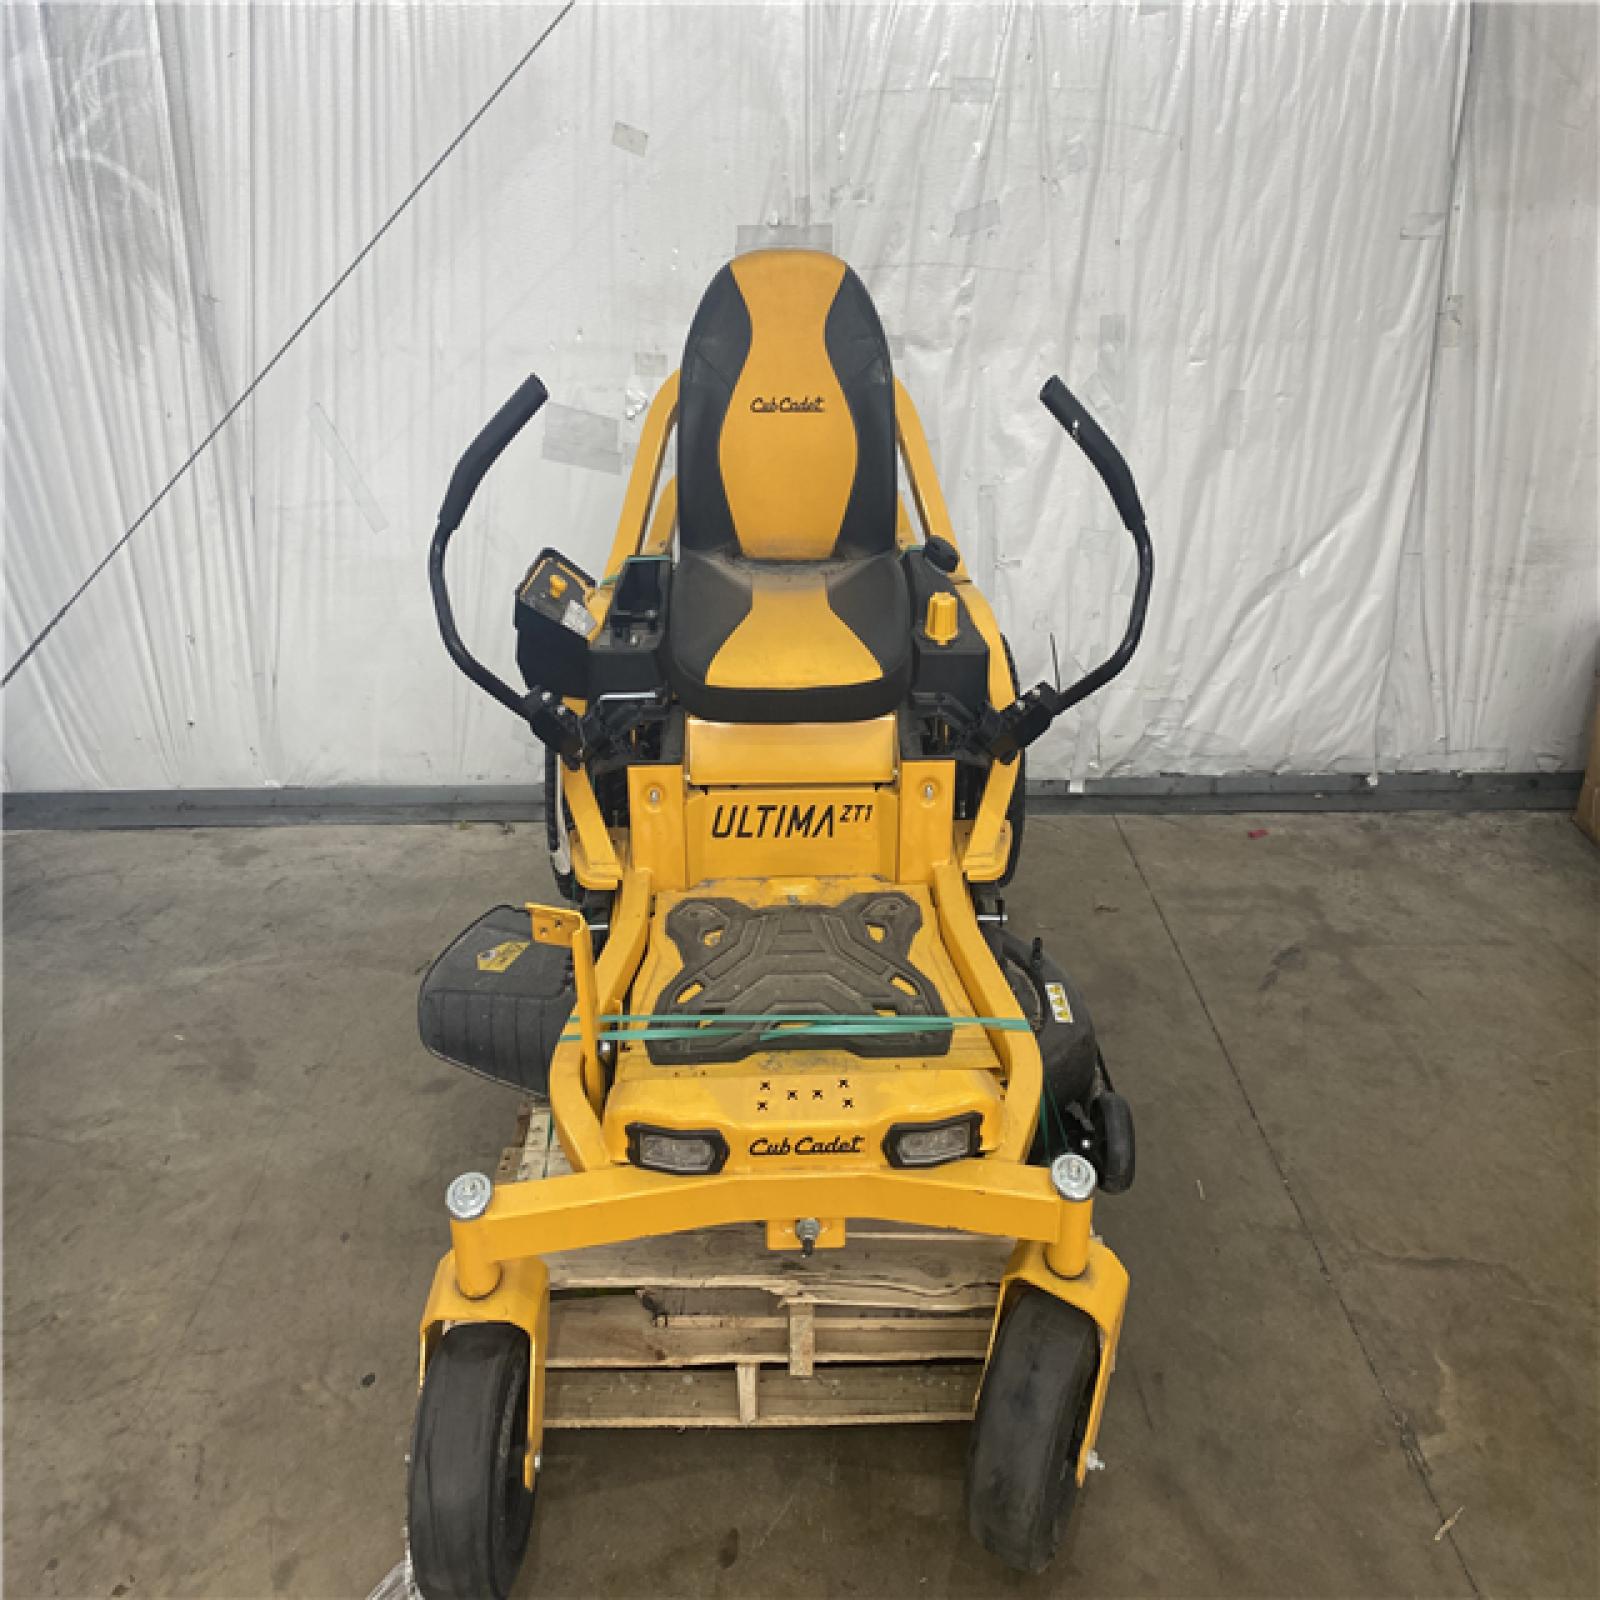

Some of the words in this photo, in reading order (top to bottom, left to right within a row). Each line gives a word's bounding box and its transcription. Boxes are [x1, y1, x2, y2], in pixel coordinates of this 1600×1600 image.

[750, 397, 777, 413] Cub
[780, 396, 825, 413] Cadet
[712, 804, 834, 838] ULTIMA
[840, 804, 874, 822] ZT1
[750, 1136, 791, 1156] Cub
[794, 1134, 865, 1156] Cadet
